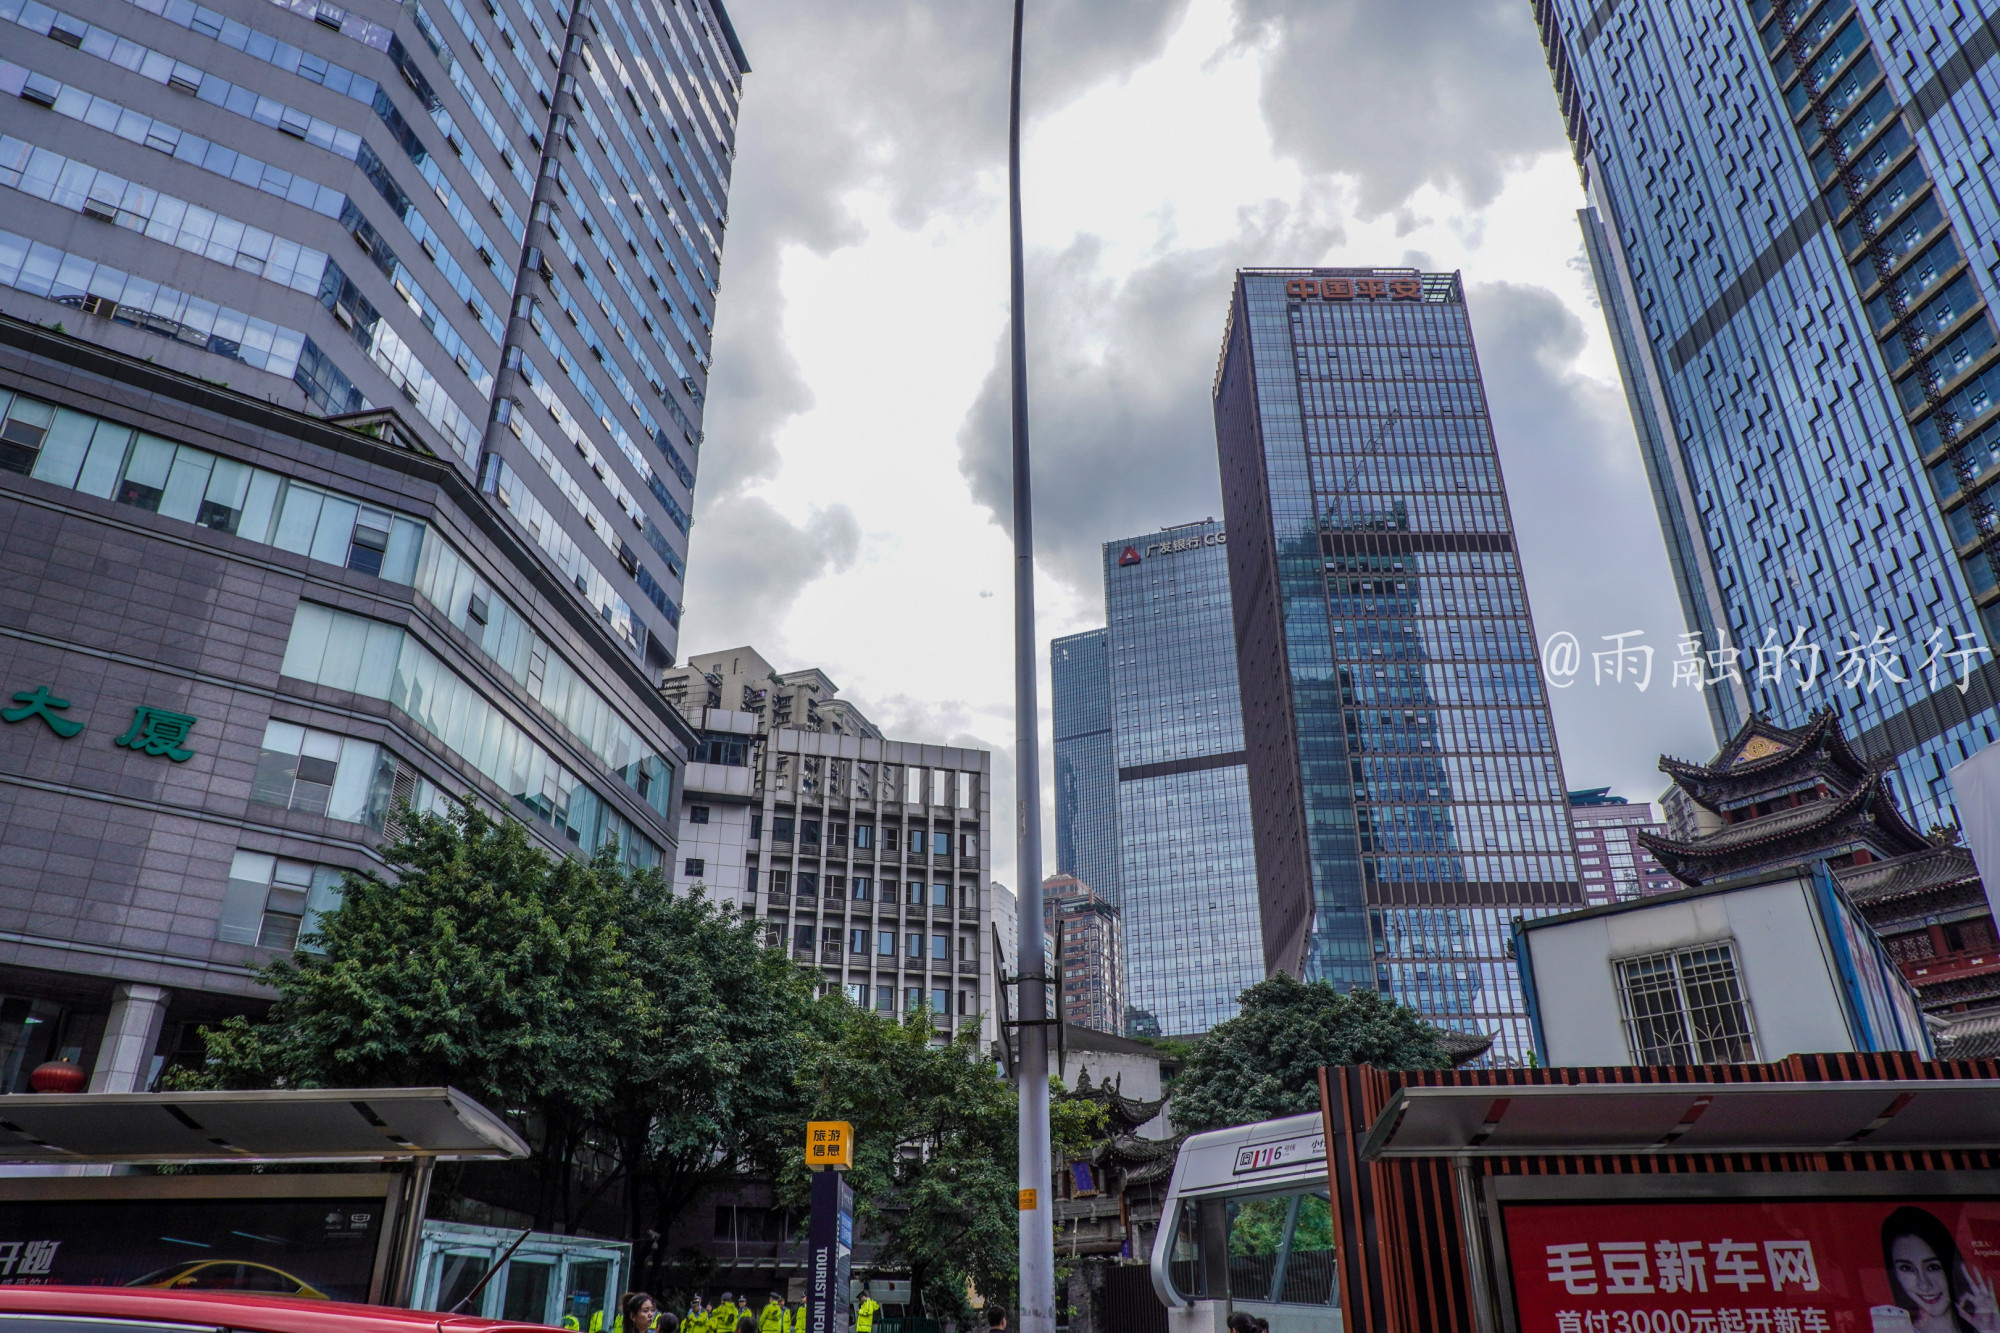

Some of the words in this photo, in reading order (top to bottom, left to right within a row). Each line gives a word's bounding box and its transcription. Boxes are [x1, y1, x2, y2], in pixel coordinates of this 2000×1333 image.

[1287, 278, 1423, 298] 中国平安
[1146, 536, 1200, 558] 广发银行
[1, 685, 197, 762] 大厦
[813, 1129, 841, 1141] 旅游
[813, 1144, 840, 1157] 信息
[1261, 1149, 1268, 1162] 1
[1274, 1146, 1283, 1160] 6
[815, 1246, 828, 1299] TOURIST
[1546, 1238, 1821, 1295] 毛豆新车网
[813, 1301, 826, 1333] INFO
[1555, 1306, 1831, 1333] 首付3000元起开新车
